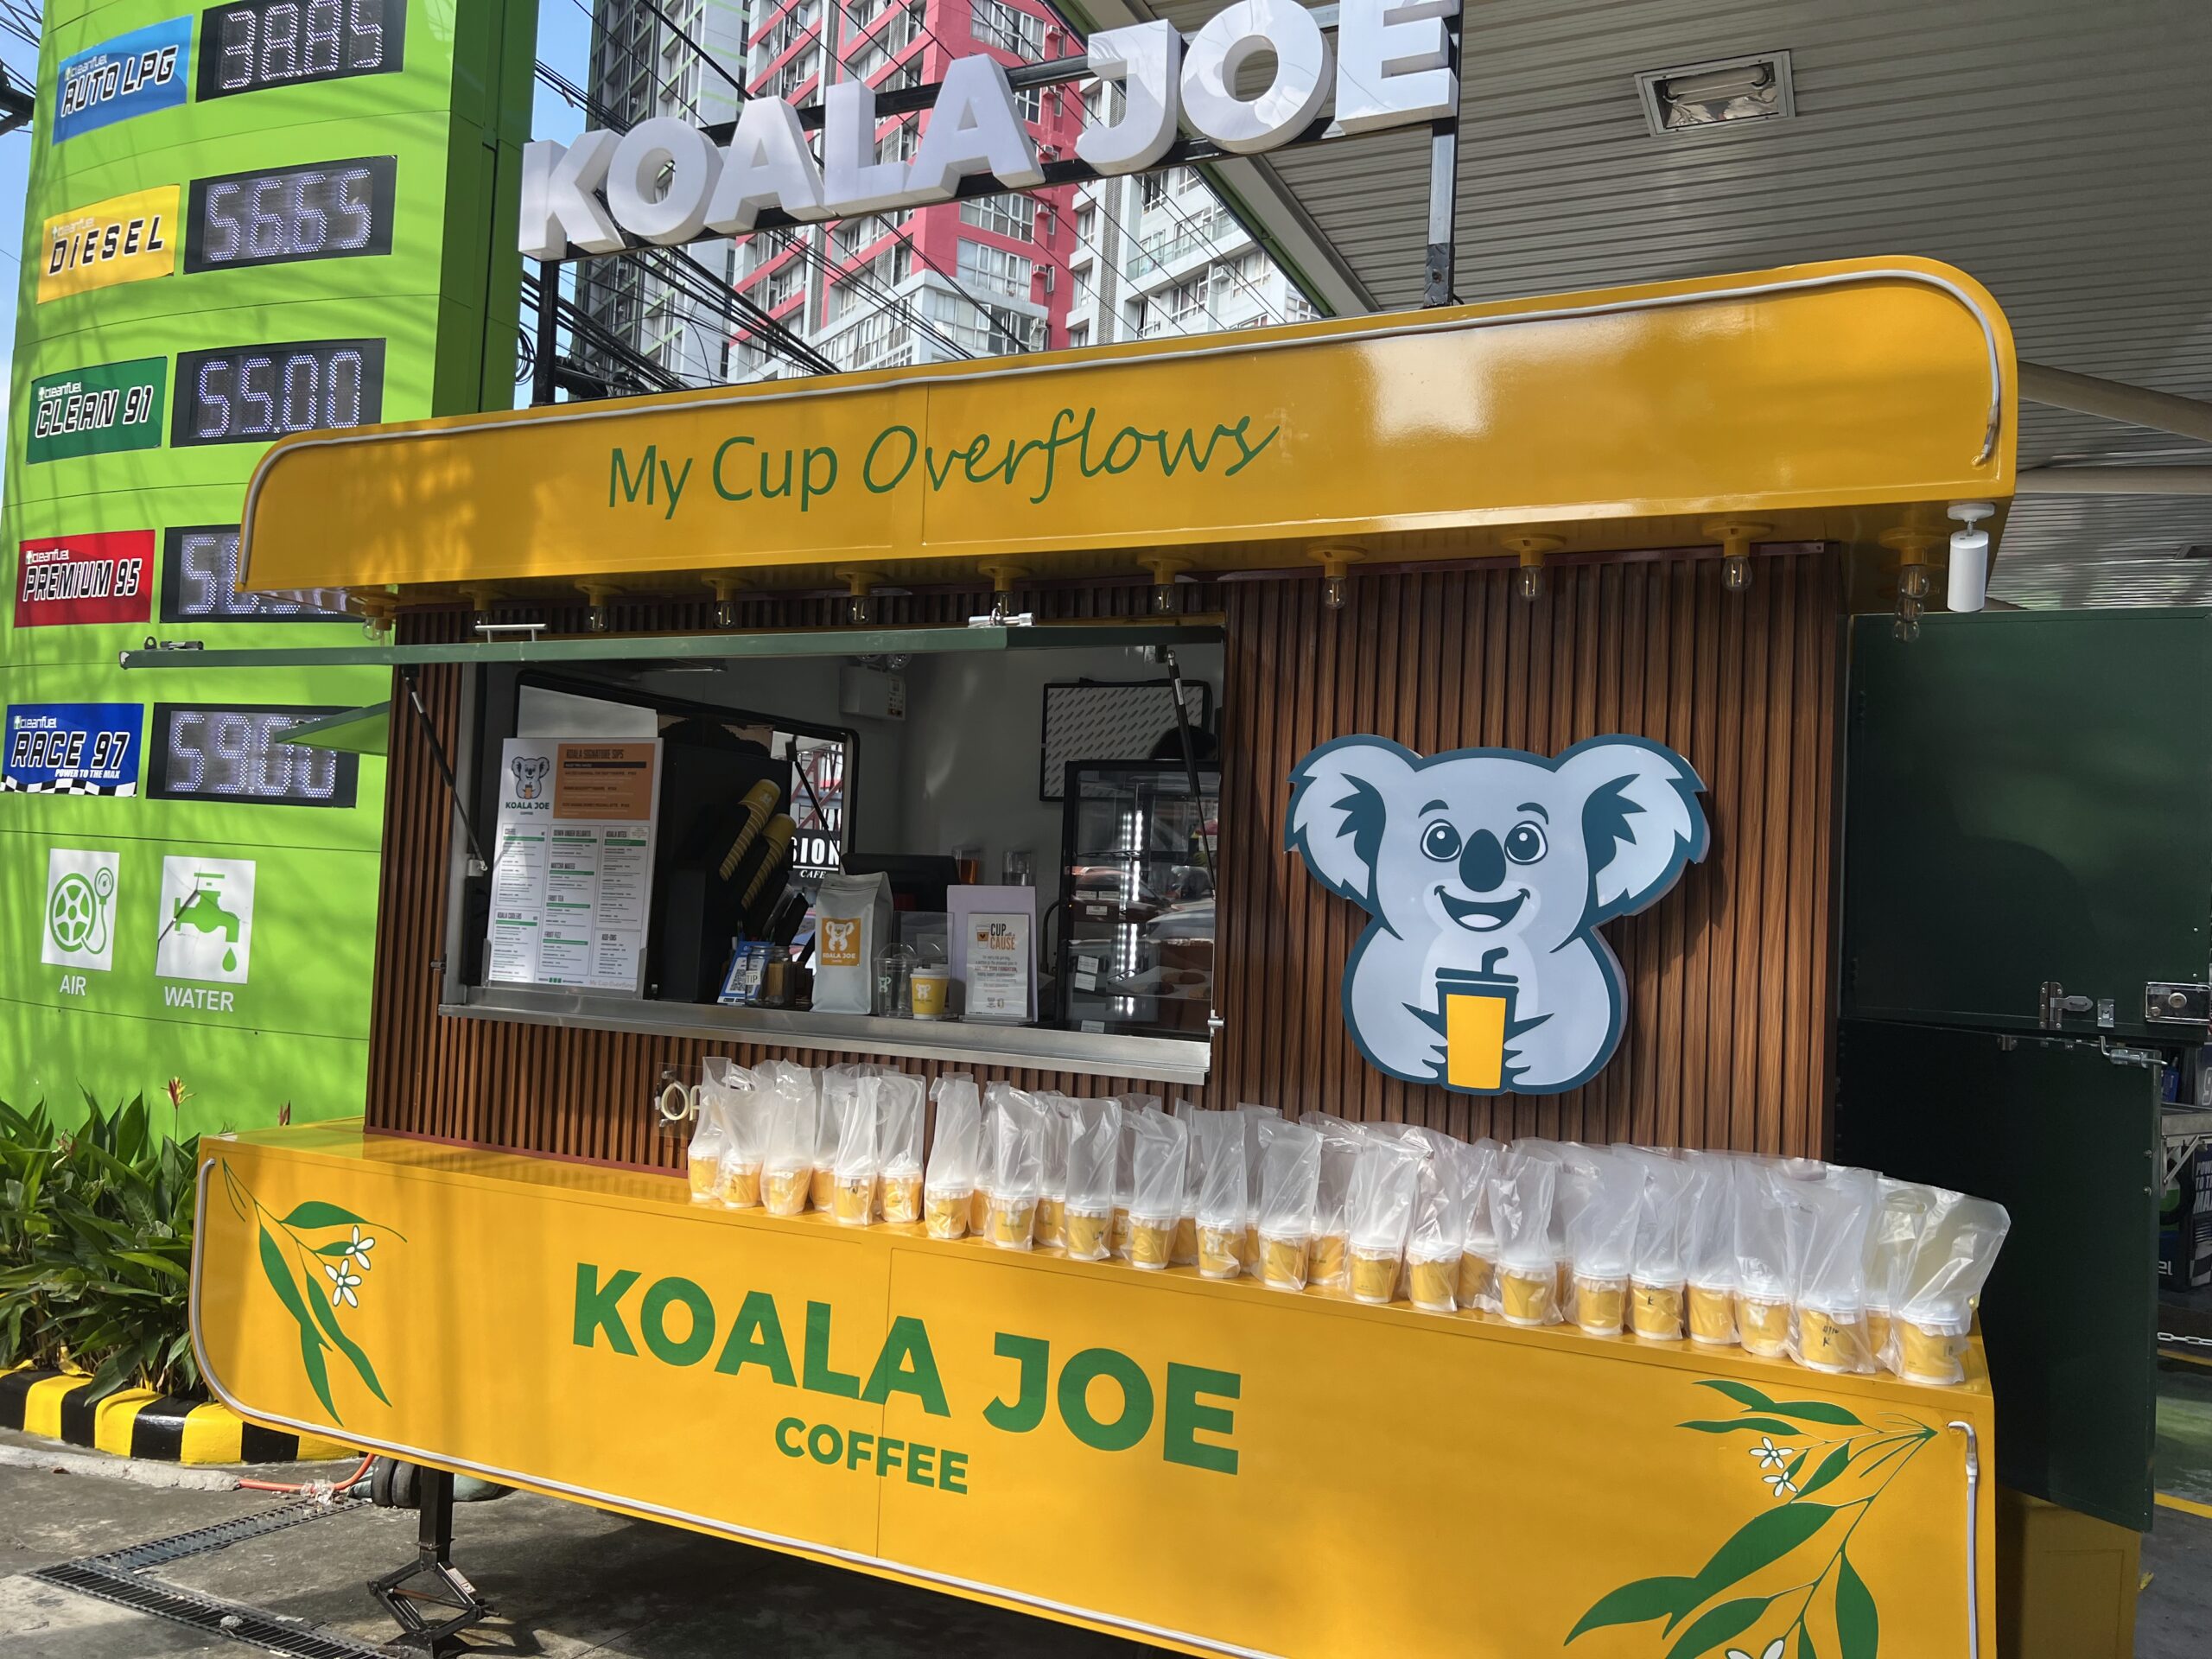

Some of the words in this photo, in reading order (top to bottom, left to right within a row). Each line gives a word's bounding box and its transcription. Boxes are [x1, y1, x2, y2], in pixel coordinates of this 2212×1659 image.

[60, 60, 121, 118] AUTO
[122, 44, 180, 93] LPG
[518, 54, 1046, 260] KOALA
[1074, 0, 1459, 175] JOE
[210, 168, 372, 261] 56.65
[48, 215, 163, 276] DIESEL
[45, 381, 81, 398] cleanfuel
[199, 351, 362, 438] 55.00
[35, 390, 119, 438] CLEAN
[123, 385, 153, 423] 91
[609, 444, 692, 519] My
[713, 436, 837, 512] Cup
[862, 406, 1280, 504] Overflows
[22, 560, 113, 603] PREMIUM
[114, 558, 142, 598] 95
[21, 715, 57, 729] cleanfuel
[10, 731, 87, 768] RACE
[90, 731, 130, 771] 97
[54, 769, 79, 778] POWER
[79, 769, 89, 778] TO
[89, 770, 105, 779] THE
[105, 770, 121, 779] MAX
[505, 802, 532, 810] KOALA
[534, 802, 550, 810] JOE
[799, 870, 826, 879] CAFE
[990, 924, 1007, 936] CUP
[990, 937, 1015, 950] CAUSE
[60, 975, 86, 996] AIR
[747, 974, 758, 983] TIP
[164, 986, 234, 1012] WATER
[573, 1262, 951, 1418] KOALA
[982, 1332, 1241, 1475] JOE
[775, 1417, 969, 1495] COFFEE
